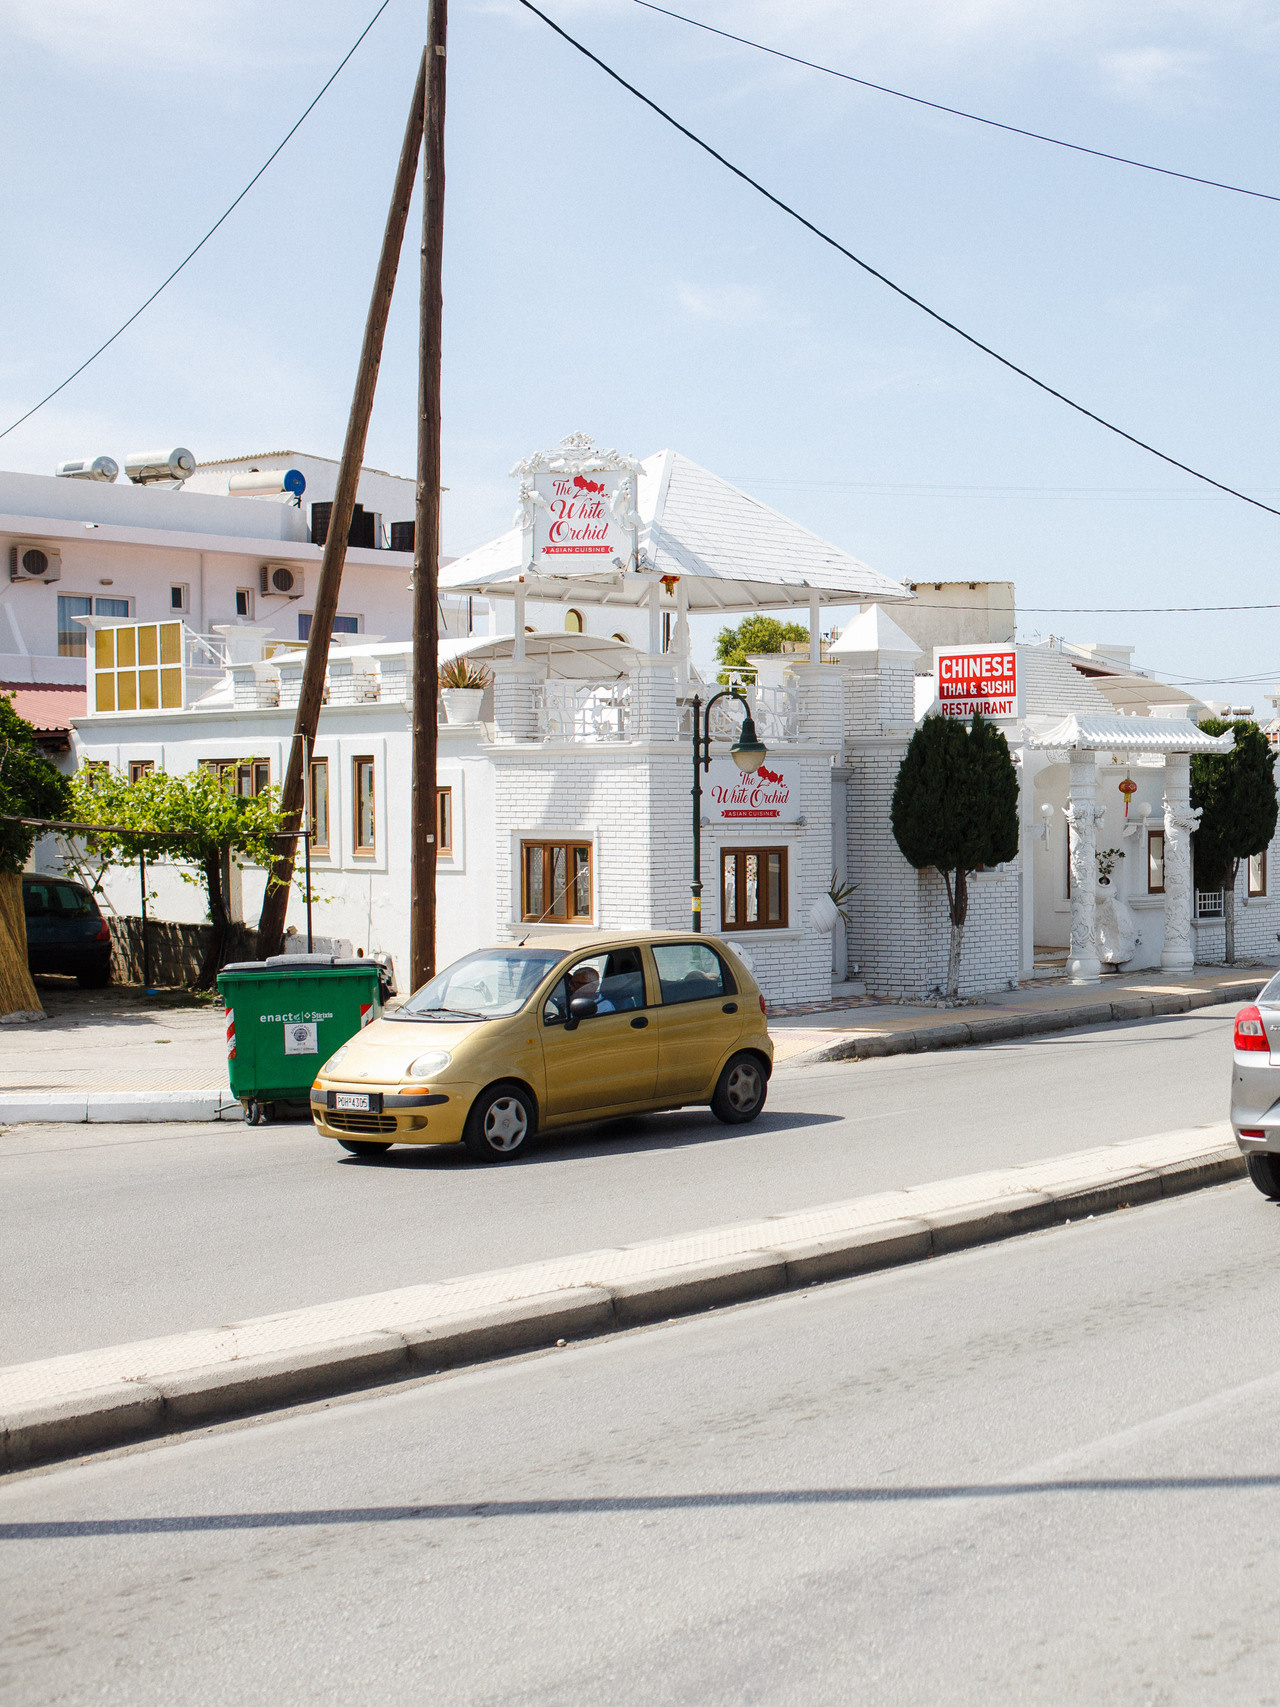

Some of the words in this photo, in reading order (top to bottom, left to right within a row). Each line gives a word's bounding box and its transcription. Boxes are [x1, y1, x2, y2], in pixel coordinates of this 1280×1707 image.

[552, 479, 573, 496] The
[550, 498, 605, 520] White
[549, 521, 608, 543] Orchid
[941, 656, 1014, 679] CHINESE
[942, 682, 967, 696] THAI
[969, 682, 978, 695] &
[980, 680, 1014, 694] SUSHI
[942, 701, 1013, 716] RESTAURANT
[740, 771, 755, 786] The
[712, 784, 749, 804] White
[750, 789, 790, 808] Orchid
